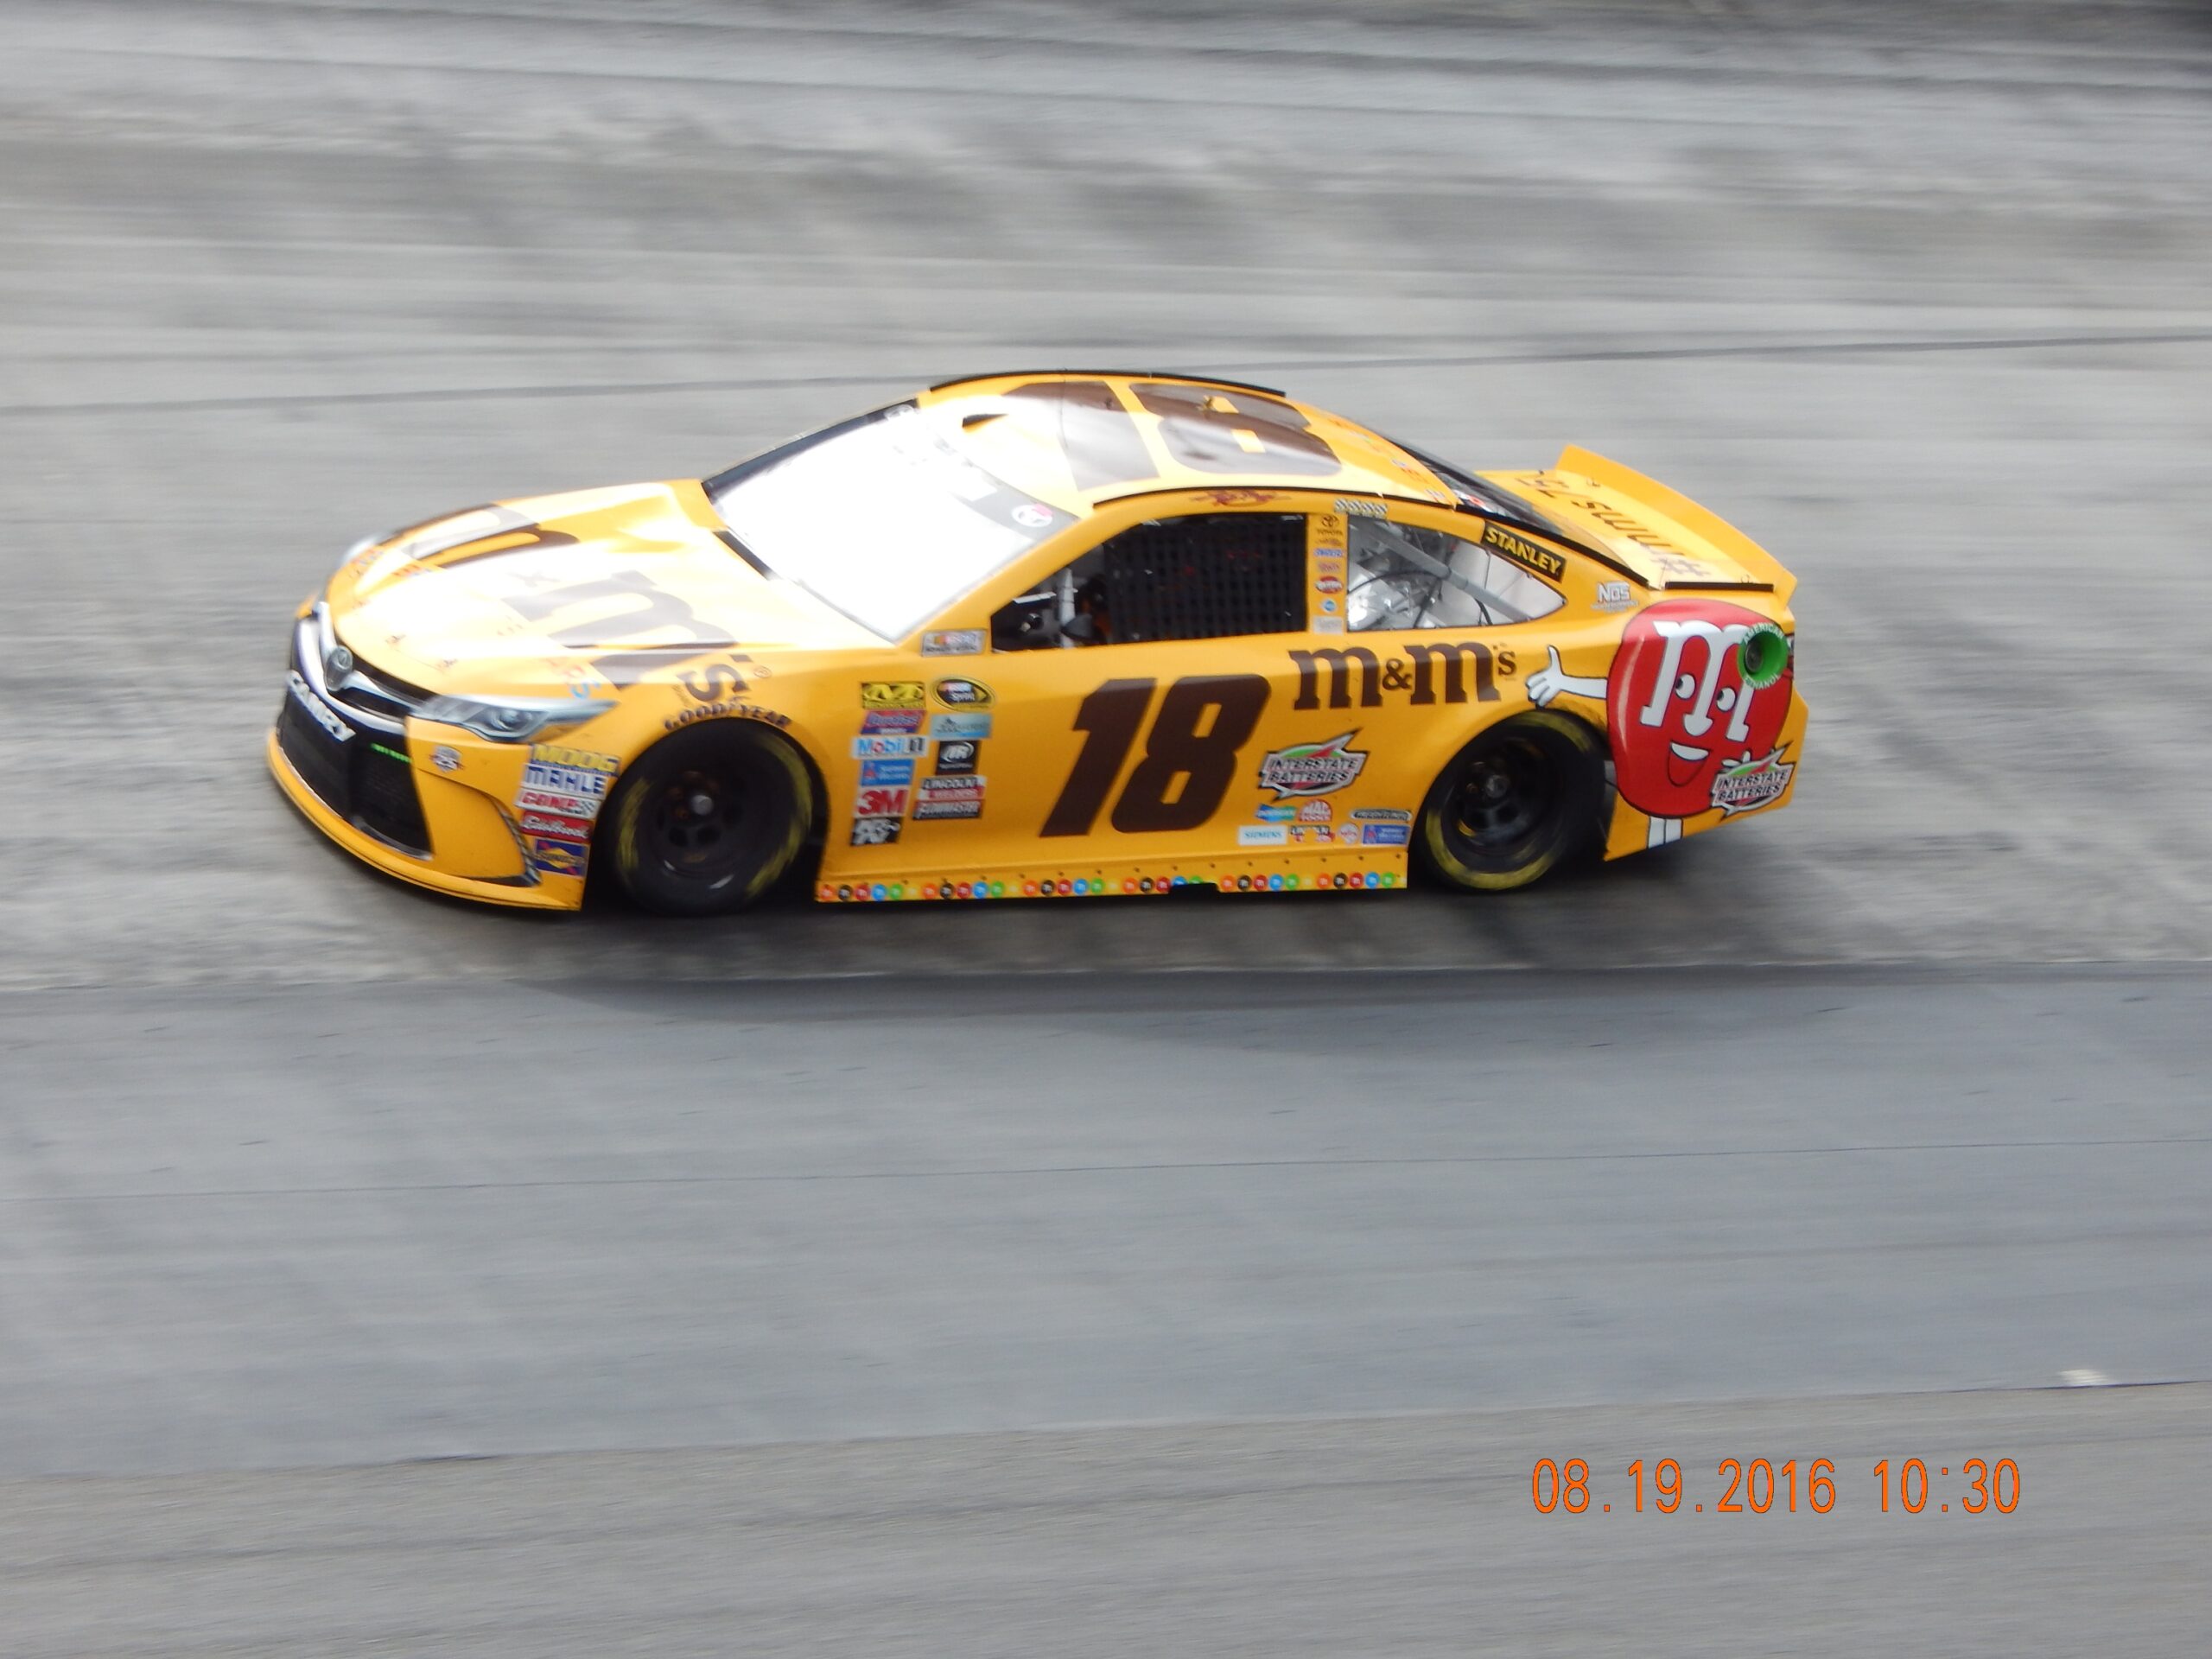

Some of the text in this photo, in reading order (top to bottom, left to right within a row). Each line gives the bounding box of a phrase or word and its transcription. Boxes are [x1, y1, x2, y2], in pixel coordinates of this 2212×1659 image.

[1484, 526, 1562, 577] STANLEY
[1597, 581, 1631, 605] NOS
[1742, 622, 1786, 645] AMERICAN
[533, 744, 620, 773] MOOG
[1039, 672, 1272, 838] 18
[1268, 758, 1358, 770] INTERSTATE
[525, 766, 606, 794] MAHLE
[1267, 769, 1350, 785] BATTERIES
[1719, 771, 1788, 789] INTERSTATE
[858, 789, 907, 817] 3M
[1717, 784, 1782, 801] BATTERIES
